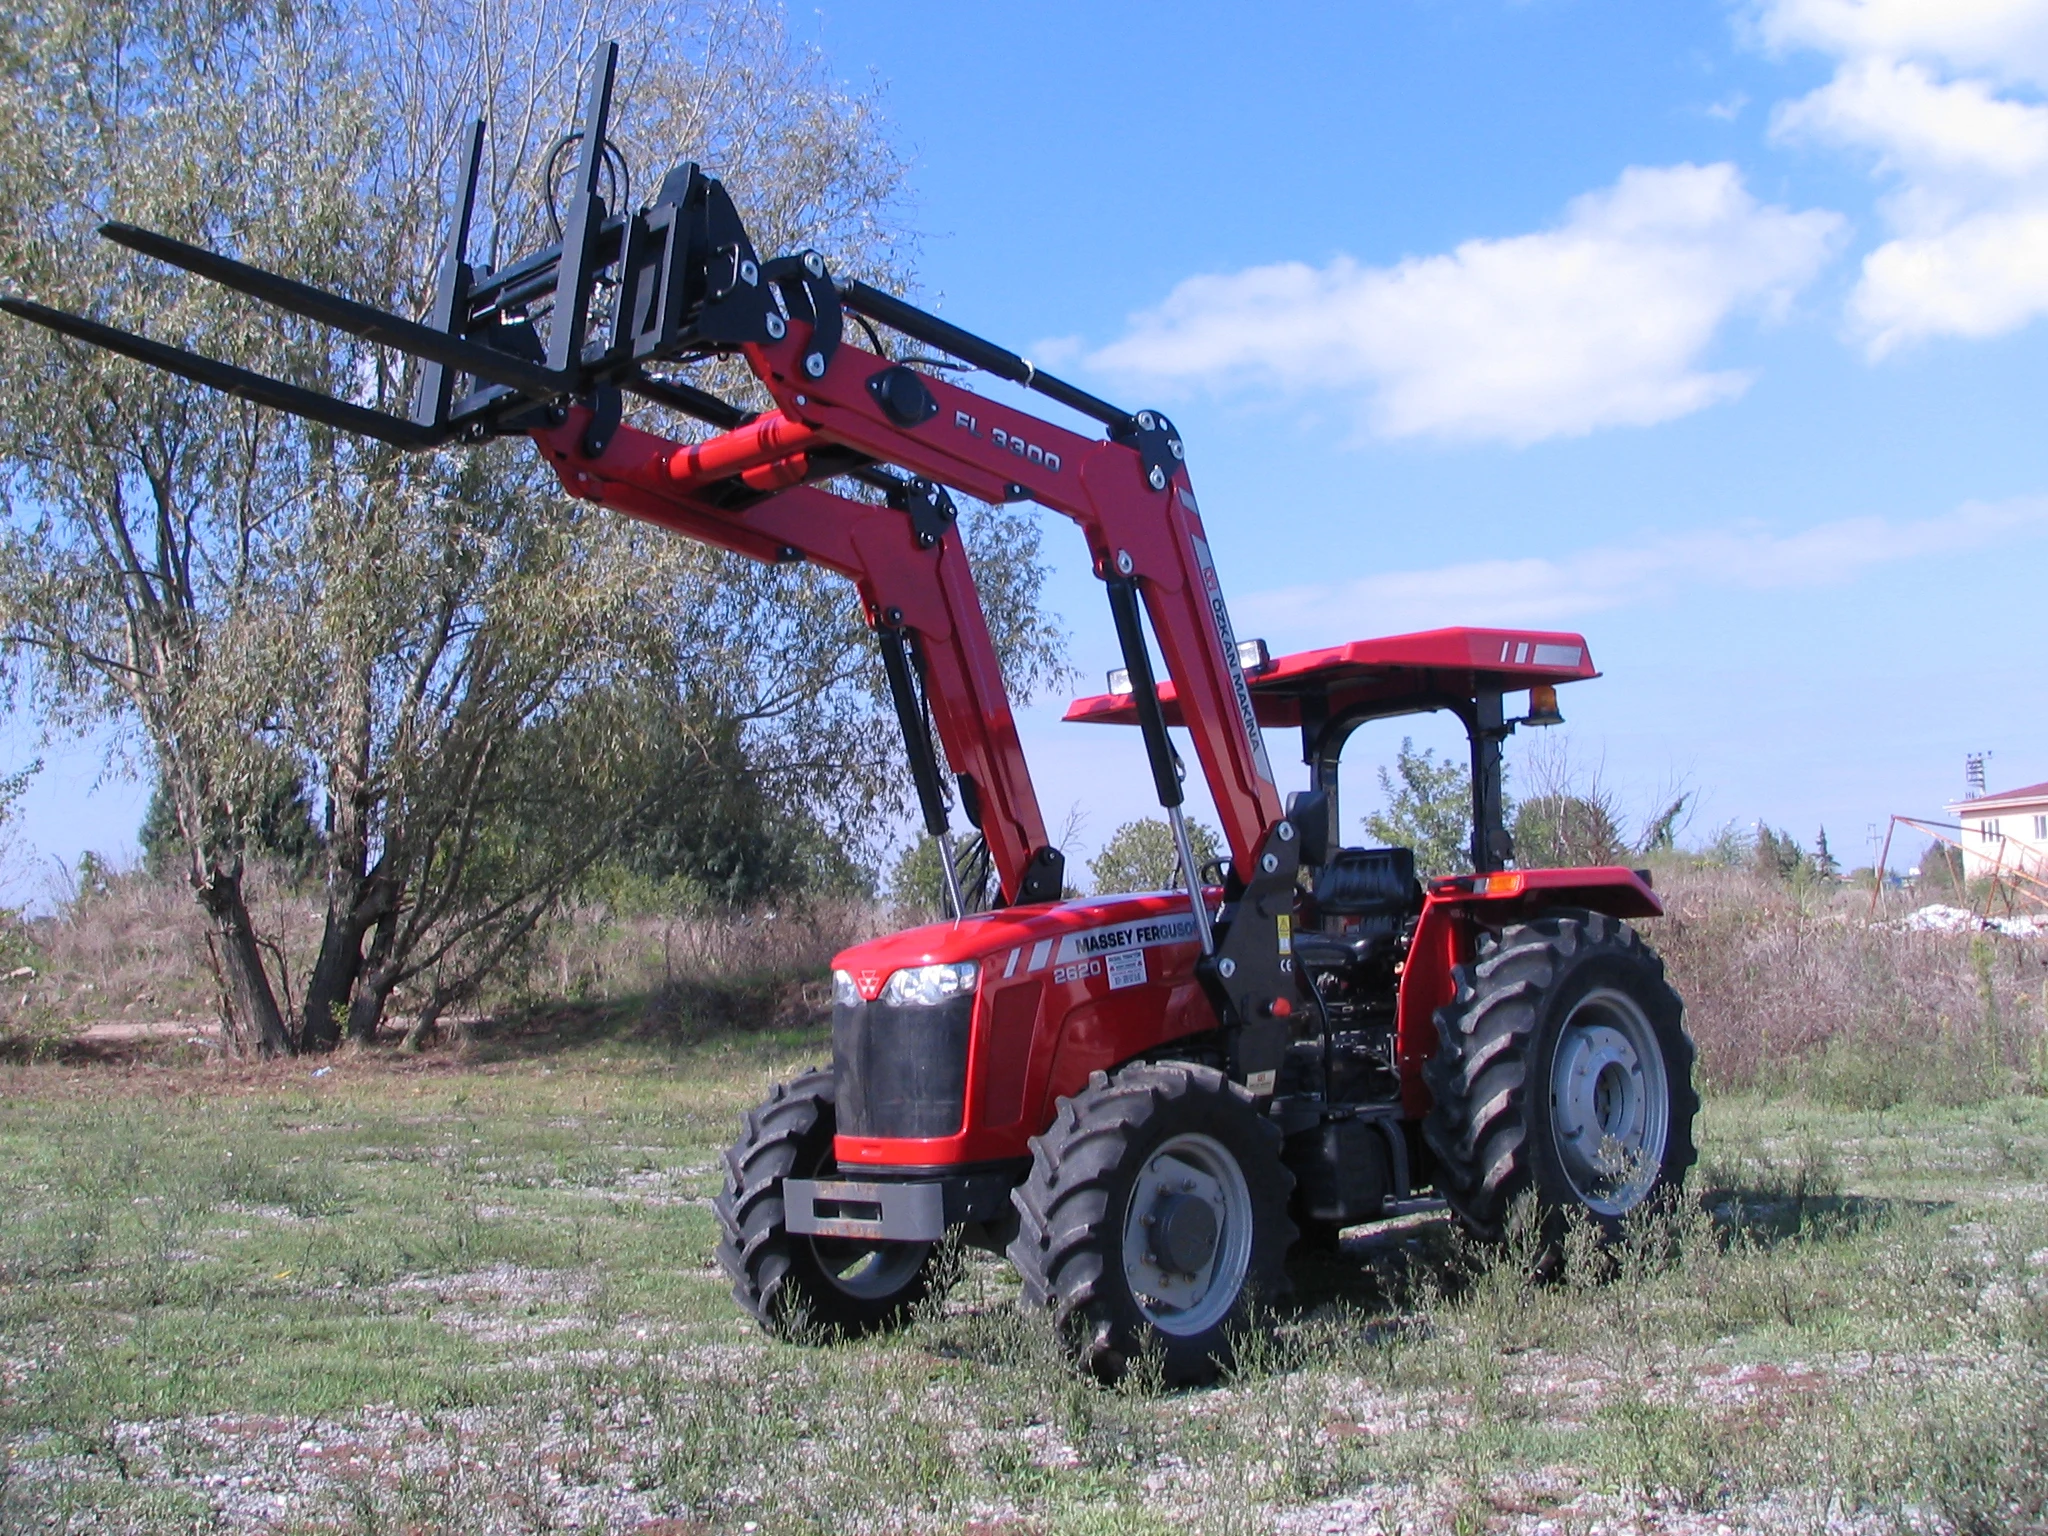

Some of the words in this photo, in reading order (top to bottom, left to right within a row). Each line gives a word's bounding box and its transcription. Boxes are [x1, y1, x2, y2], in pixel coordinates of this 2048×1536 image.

[954, 409, 983, 438] FL
[991, 427, 1061, 473] 3300
[1075, 927, 1134, 955] MASSEY
[1054, 960, 1101, 984] 2620
